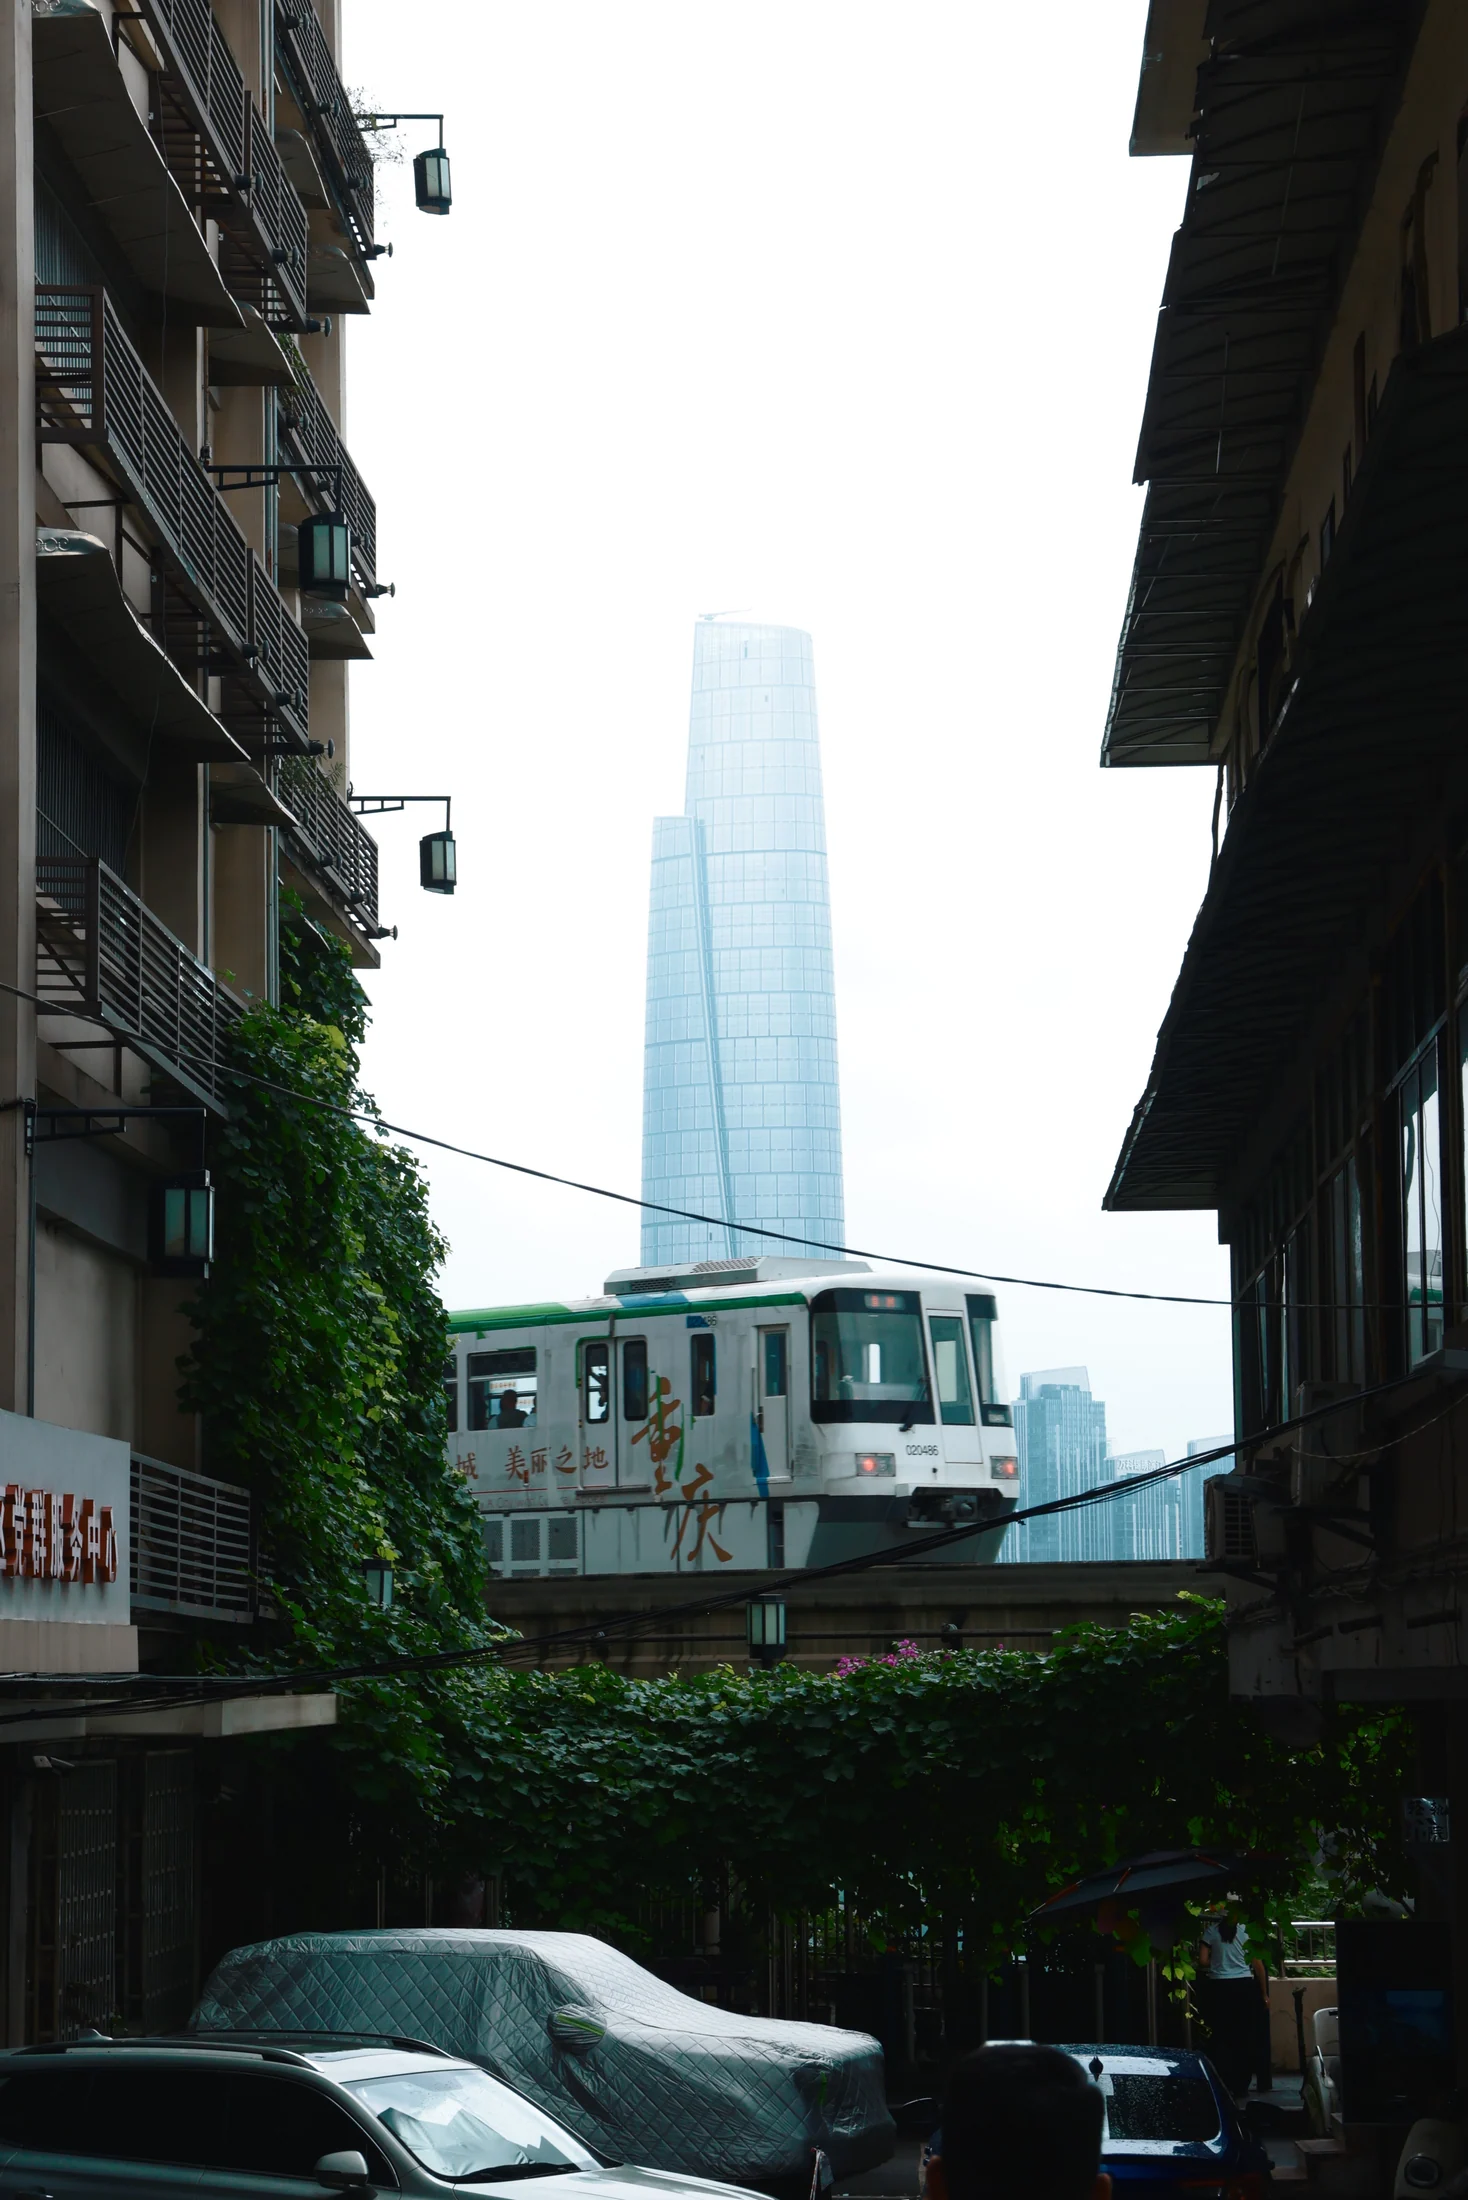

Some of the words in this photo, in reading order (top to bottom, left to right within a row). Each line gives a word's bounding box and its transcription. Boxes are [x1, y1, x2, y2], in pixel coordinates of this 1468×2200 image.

[504, 1444, 609, 1481] 美丽之地
[906, 1445, 939, 1456] 020486
